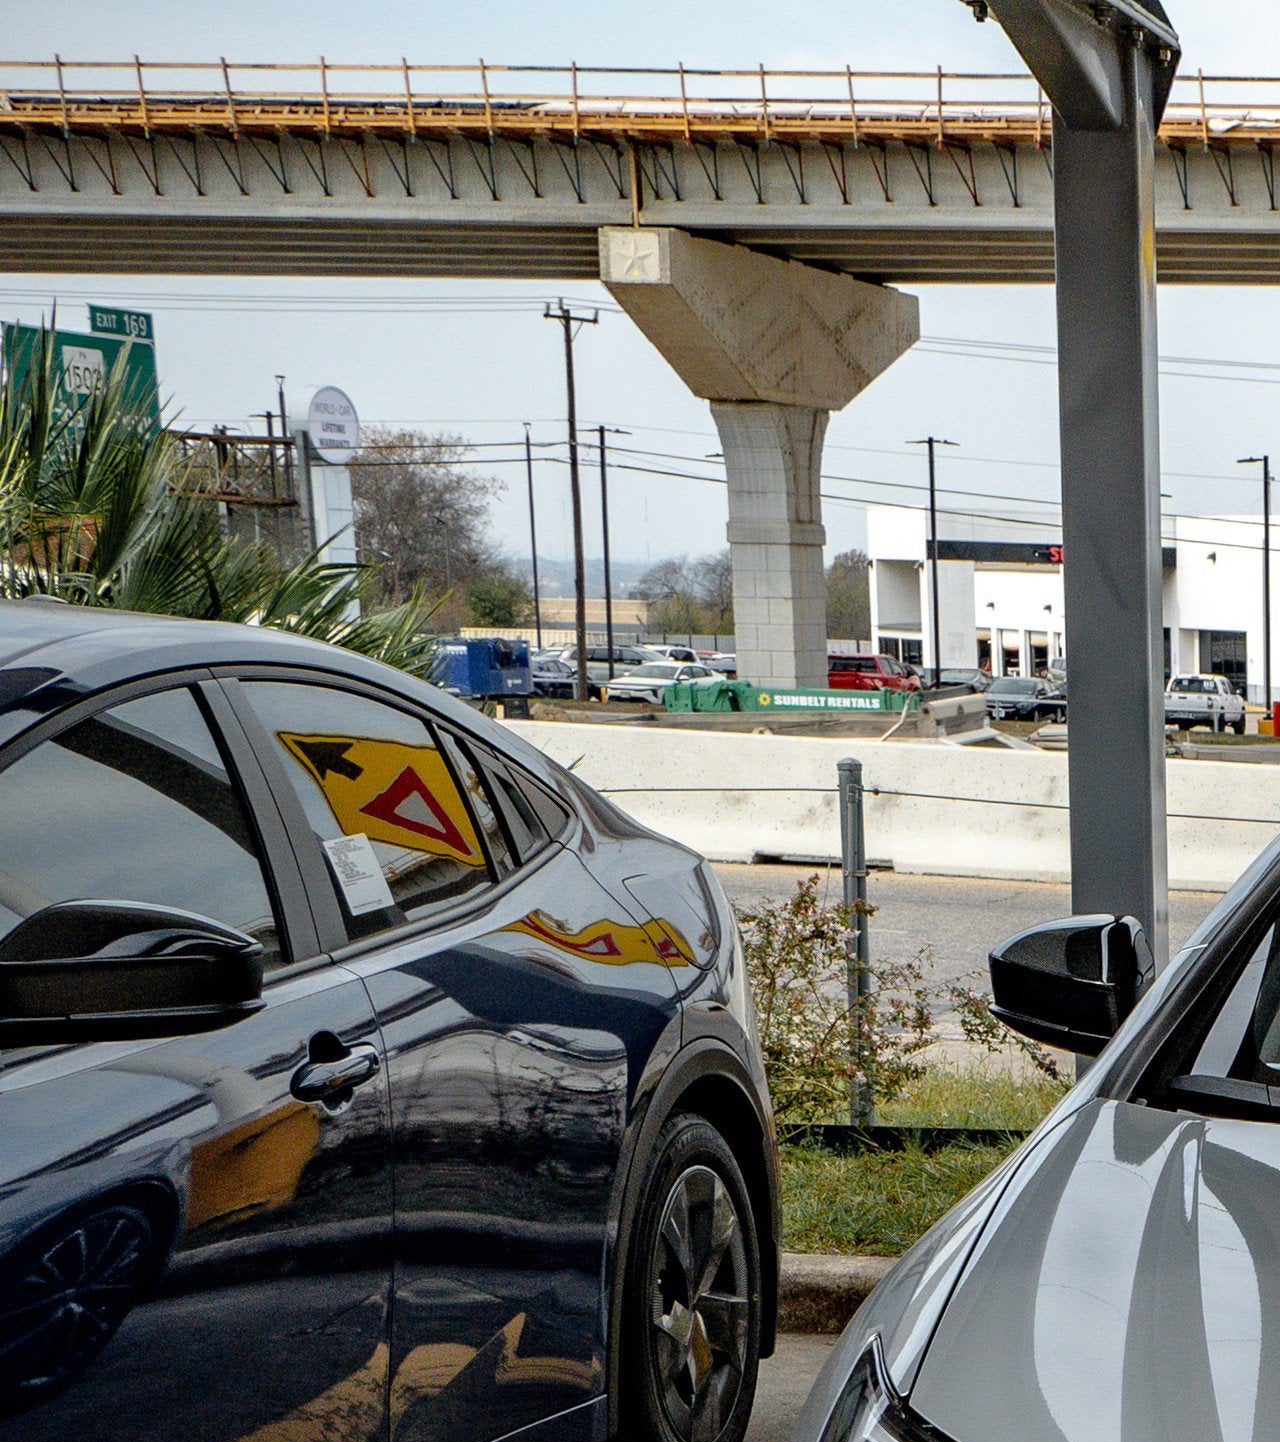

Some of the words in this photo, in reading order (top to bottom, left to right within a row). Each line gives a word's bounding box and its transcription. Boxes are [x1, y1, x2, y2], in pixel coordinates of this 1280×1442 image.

[95, 312, 118, 329] EXIT
[123, 314, 148, 337] 169
[774, 694, 826, 707] SUNBELT
[827, 696, 880, 709] RENTALS
